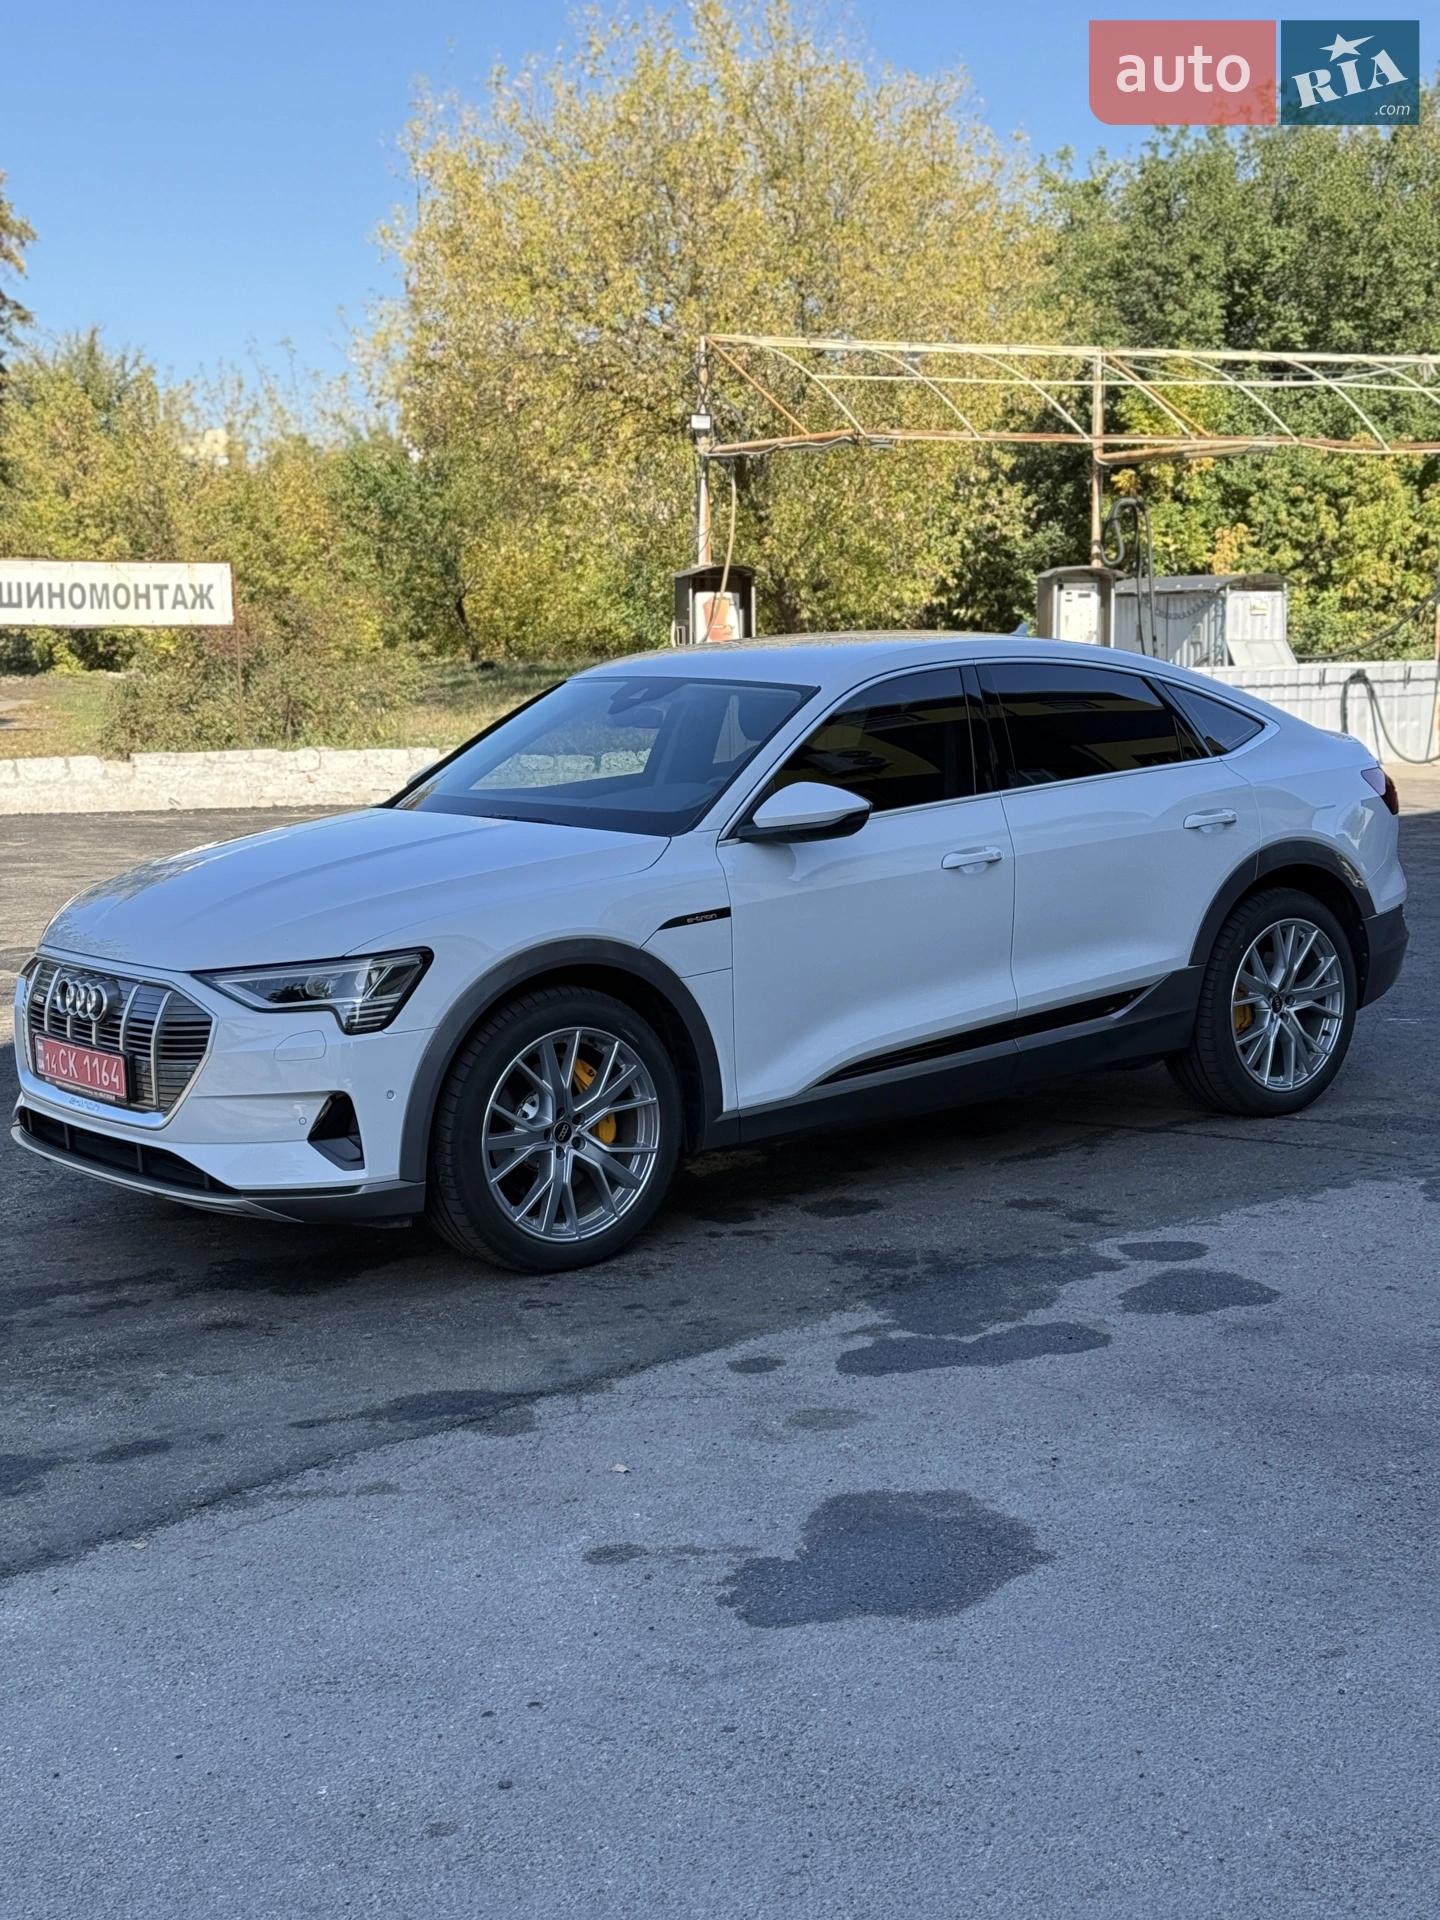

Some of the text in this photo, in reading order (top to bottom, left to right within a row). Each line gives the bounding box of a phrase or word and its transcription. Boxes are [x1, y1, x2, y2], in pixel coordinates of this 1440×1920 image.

[0, 581, 215, 610] ШИНОМОНТАЖ
[686, 913, 717, 924] e-tron
[83, 1055, 120, 1089] 1164
